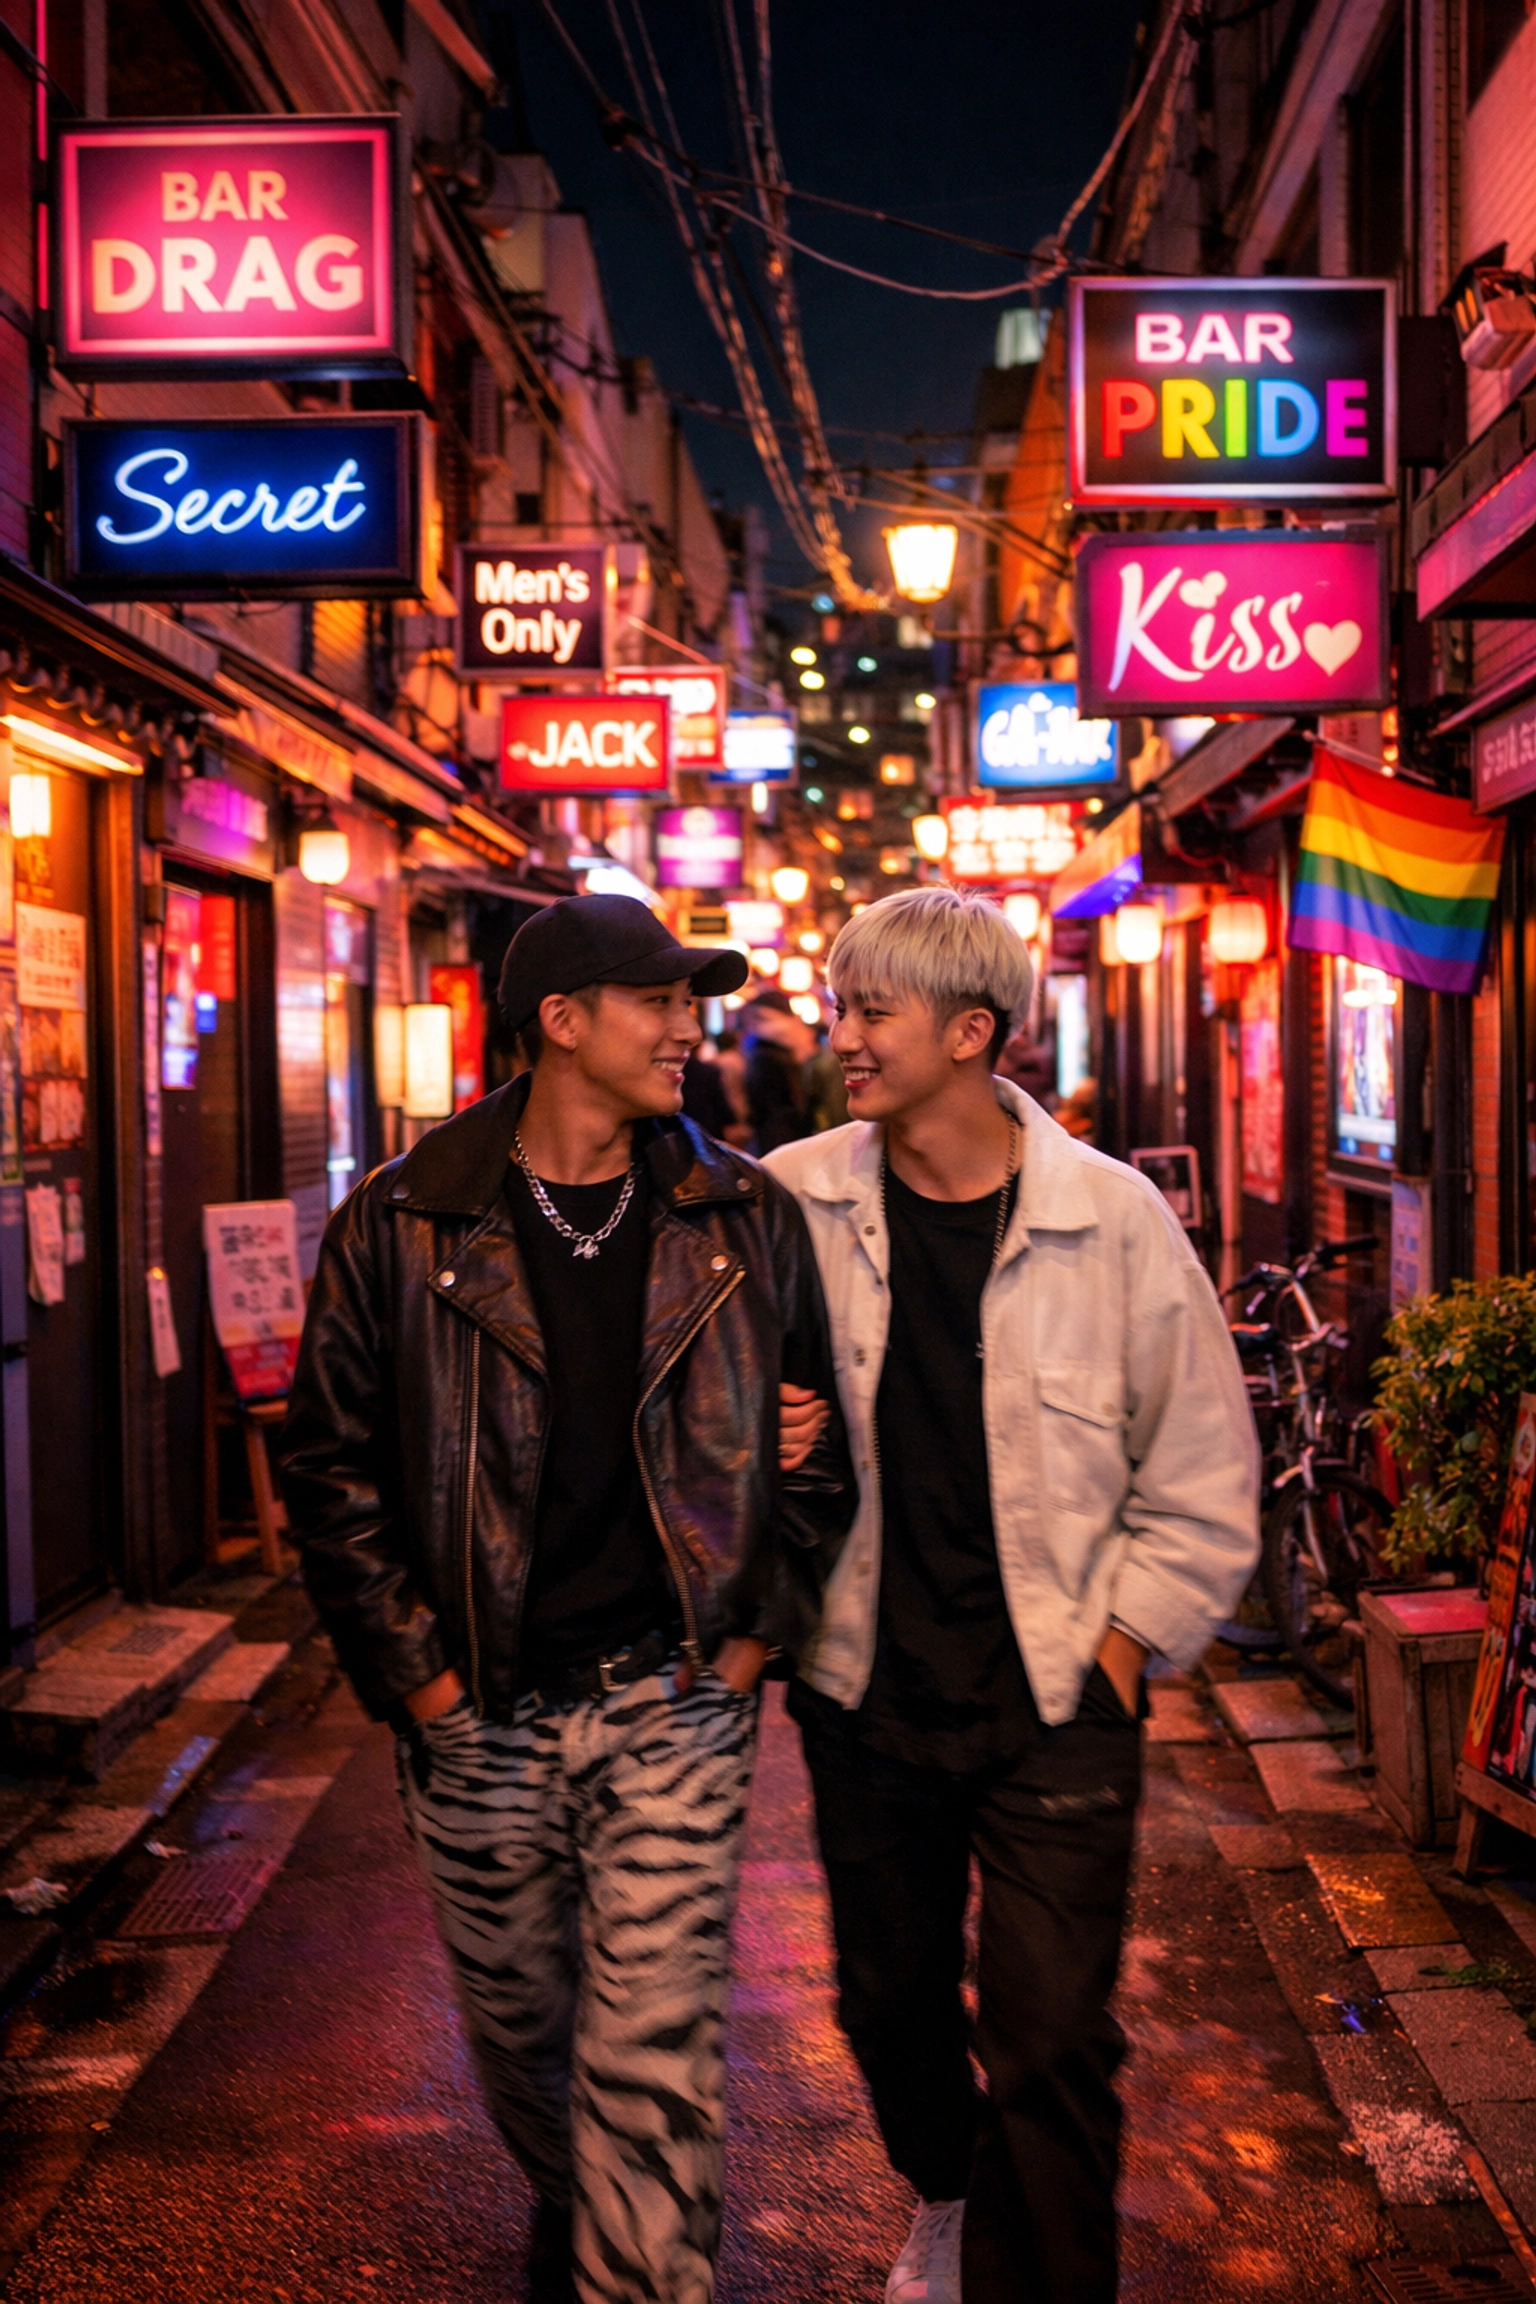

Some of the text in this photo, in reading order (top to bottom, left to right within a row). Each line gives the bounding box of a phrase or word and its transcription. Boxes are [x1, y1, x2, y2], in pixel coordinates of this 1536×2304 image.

[161, 170, 288, 222] BAR
[91, 235, 365, 313] DRAG
[1135, 313, 1294, 363] BAR
[1102, 379, 1369, 459] PRIDE
[96, 448, 366, 544] Secret
[475, 560, 590, 604] Men's
[481, 607, 583, 664] Only
[1108, 562, 1304, 692] Kiss
[528, 720, 658, 768] JACK
